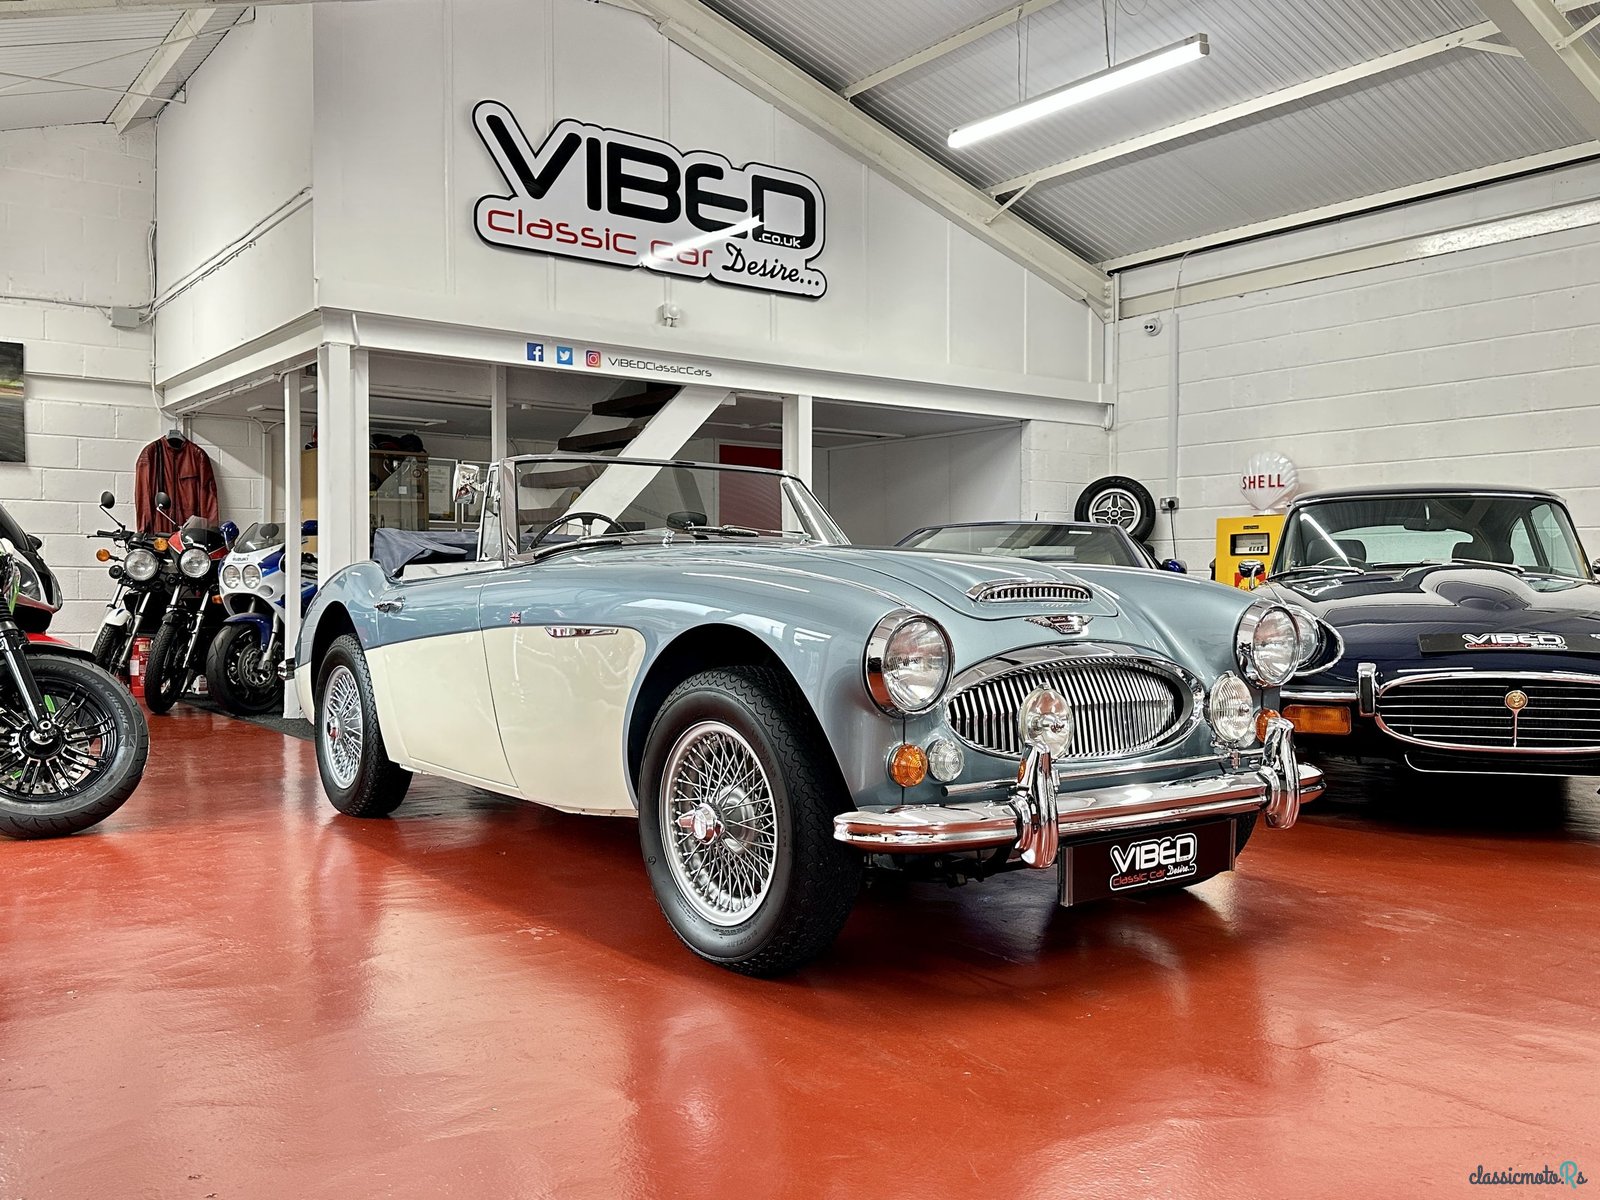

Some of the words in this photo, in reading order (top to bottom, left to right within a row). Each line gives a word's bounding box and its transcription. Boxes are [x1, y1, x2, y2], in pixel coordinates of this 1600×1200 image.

[486, 114, 817, 250] VIBED
[487, 208, 637, 256] classic
[650, 240, 713, 268] car
[721, 242, 820, 287] Desire...
[758, 232, 801, 249] .co.uk
[607, 356, 712, 378] VIBEDClassicCars
[1242, 474, 1285, 490] SHELL
[1113, 837, 1194, 873] VIBED
